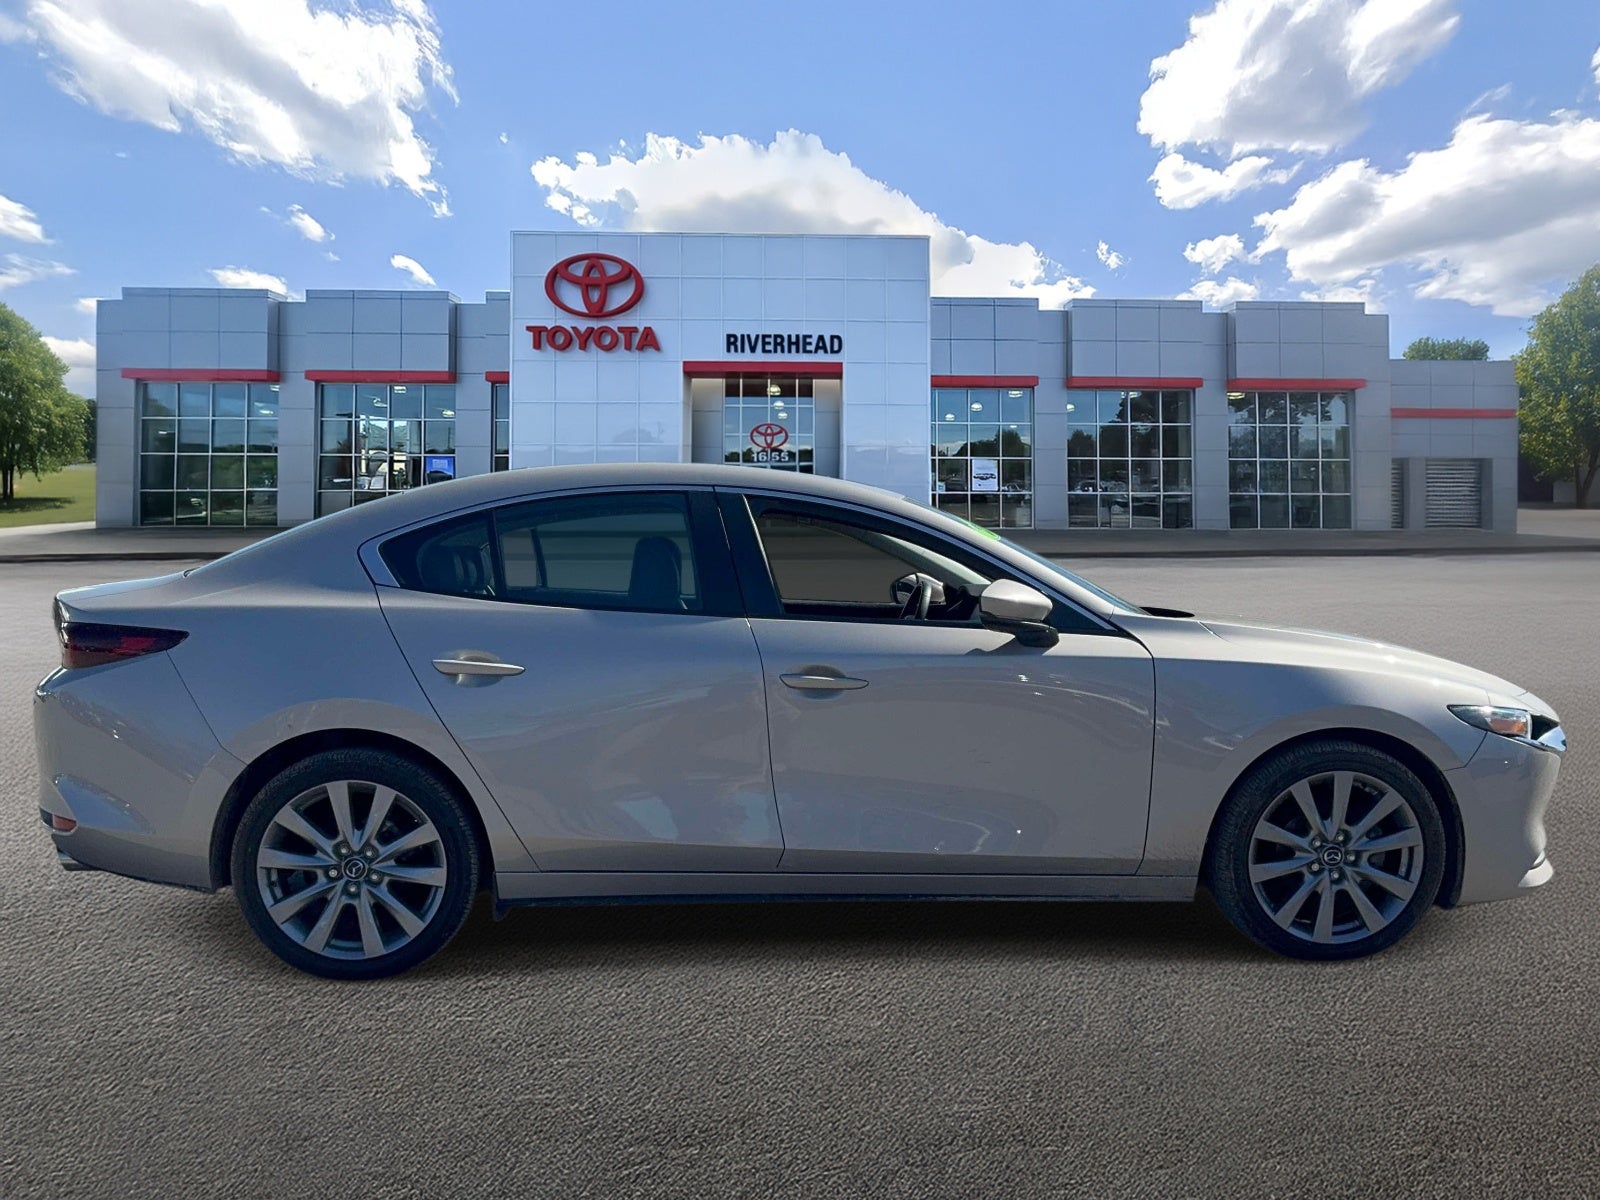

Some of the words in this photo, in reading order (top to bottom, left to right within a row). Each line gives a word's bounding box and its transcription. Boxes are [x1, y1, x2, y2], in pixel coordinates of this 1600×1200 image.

[526, 325, 661, 352] TOYOTA
[726, 334, 843, 354] RIVERHEAD
[752, 452, 789, 462] 1655
